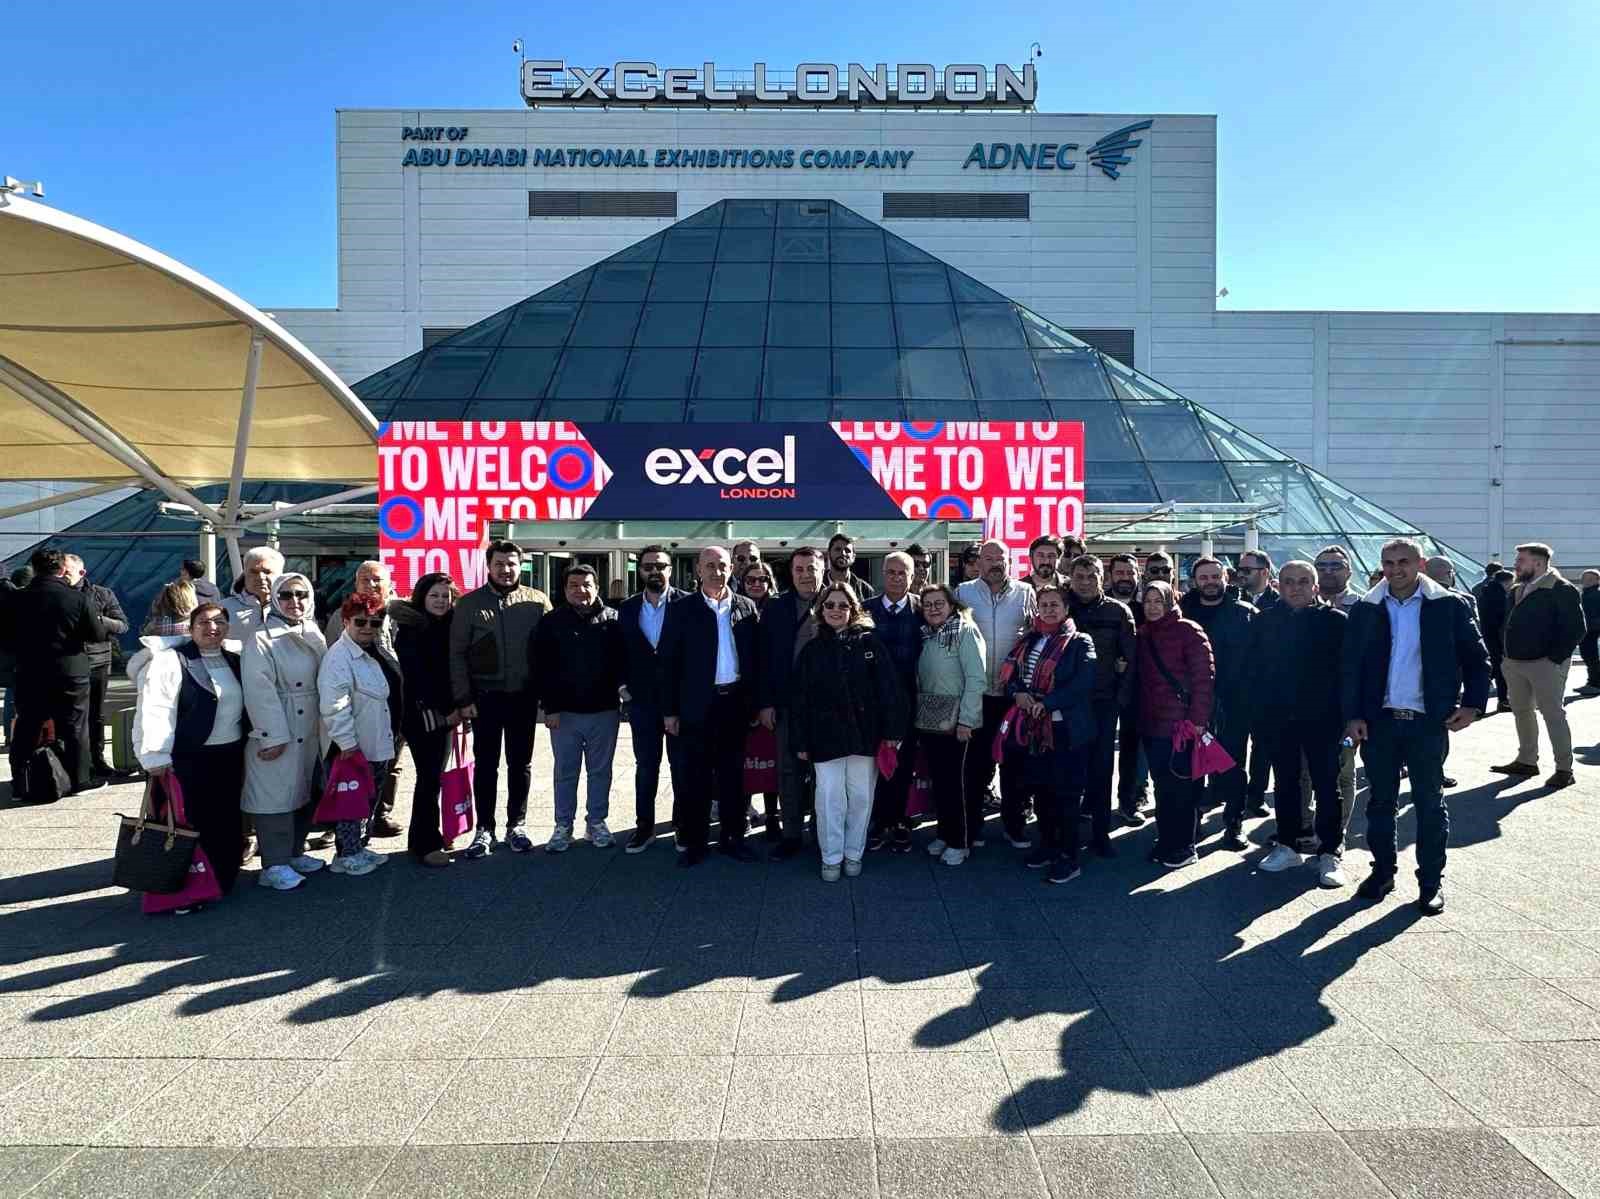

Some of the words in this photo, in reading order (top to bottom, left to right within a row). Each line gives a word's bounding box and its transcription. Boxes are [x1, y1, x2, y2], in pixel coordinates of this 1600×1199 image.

[754, 63, 1035, 102] LONDON
[401, 127, 444, 141] PART
[447, 127, 468, 141] OF
[402, 149, 451, 167] ABU
[455, 149, 528, 167] DHABI
[533, 149, 648, 168] NATIONAL
[654, 149, 795, 168] EXHIBITIONS
[800, 150, 914, 169] COMPANY
[962, 142, 1079, 170] ADNEC
[379, 446, 428, 491] TO
[645, 435, 795, 485] excel
[933, 446, 984, 490] TO
[1005, 446, 1084, 490] WEL
[720, 488, 795, 498] LONDON
[1033, 497, 1083, 538] TO
